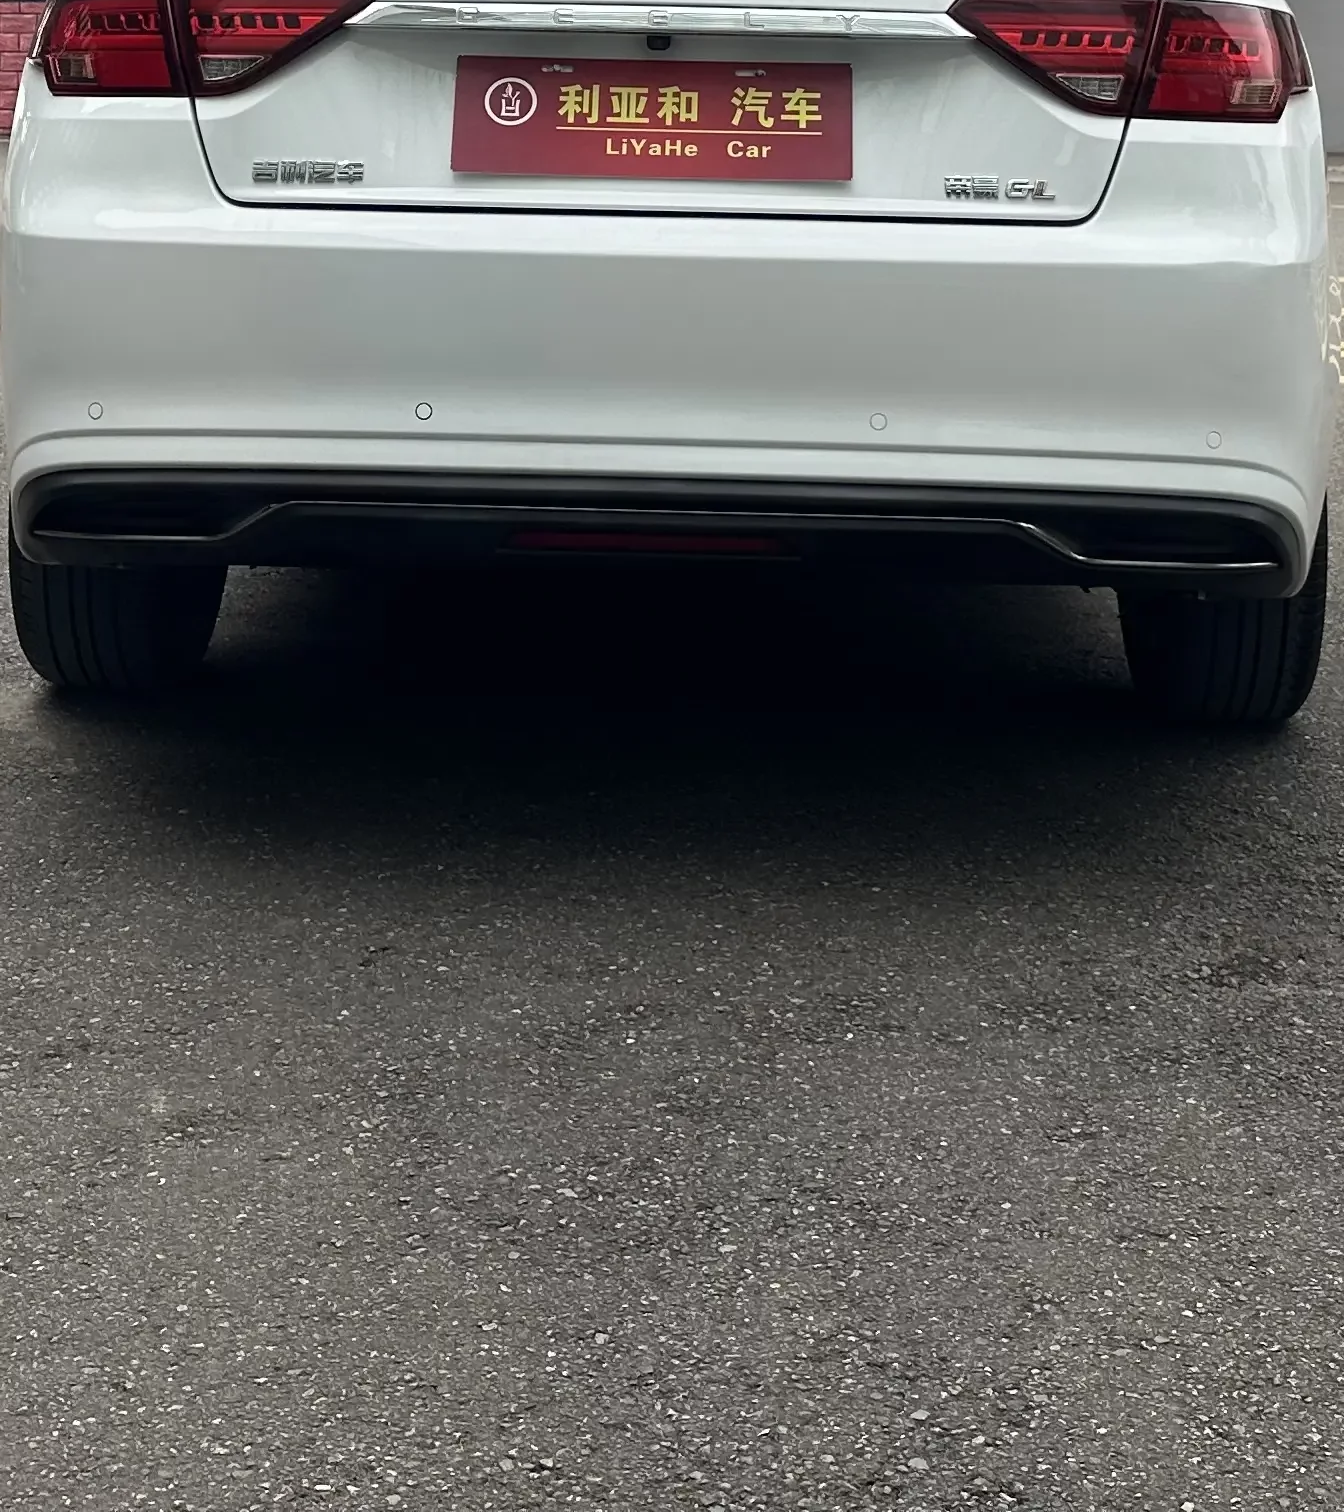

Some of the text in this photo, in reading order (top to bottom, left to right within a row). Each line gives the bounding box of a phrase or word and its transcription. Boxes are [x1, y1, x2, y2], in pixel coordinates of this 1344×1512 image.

[557, 83, 823, 129] 利亚和 汽车
[606, 137, 772, 158] LiYaHe Car
[252, 159, 364, 185] 吉利汽车
[944, 173, 1056, 200] 帝豪 GL
